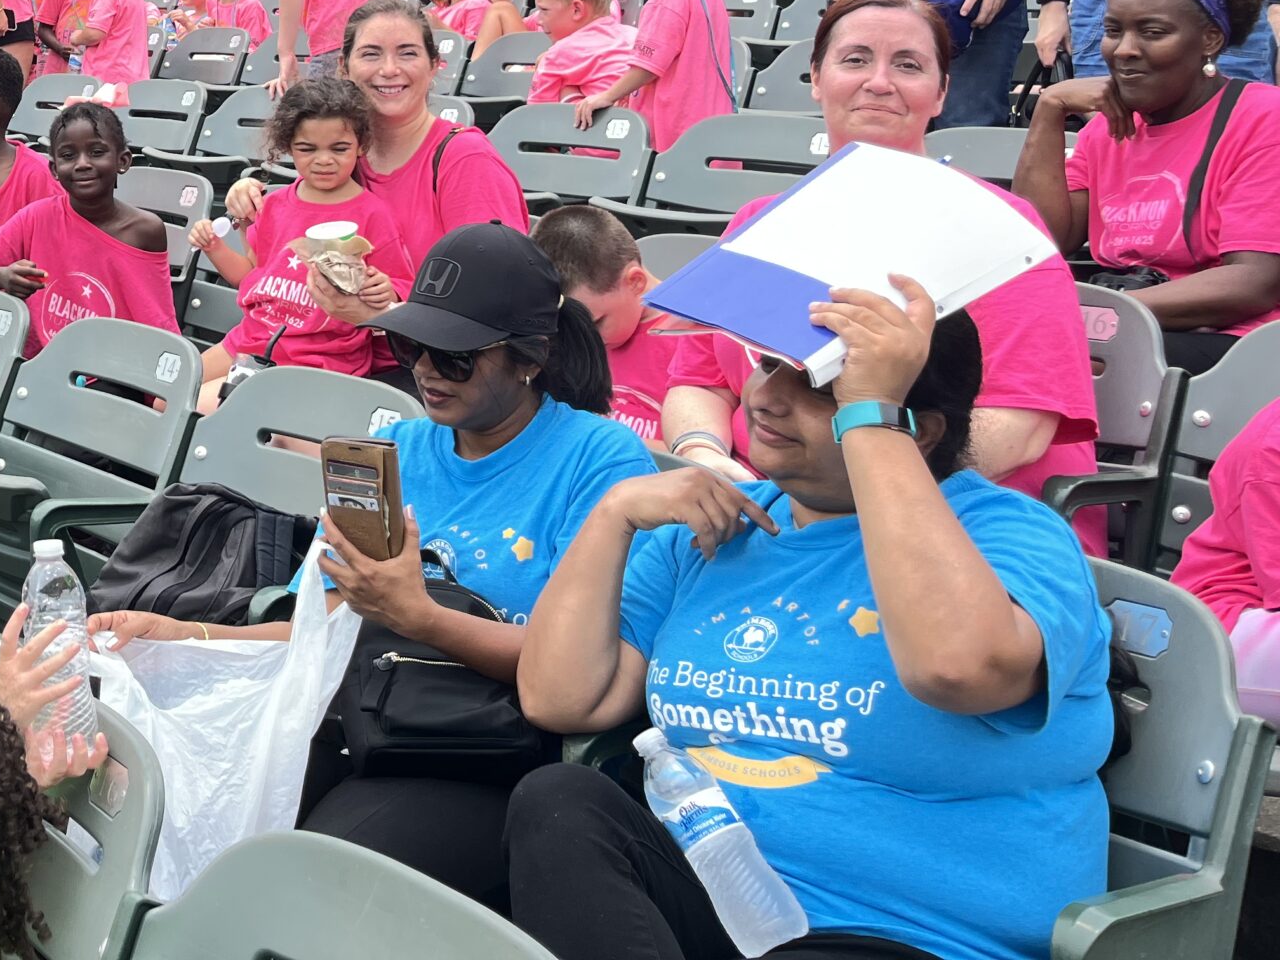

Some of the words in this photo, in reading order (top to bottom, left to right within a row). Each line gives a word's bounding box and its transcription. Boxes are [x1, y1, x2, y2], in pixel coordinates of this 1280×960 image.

[48, 292, 99, 322] BLACKM
[161, 356, 176, 378] 14
[772, 597, 810, 622] ART
[1118, 611, 1159, 647] 17
[673, 660, 841, 711] Beginning
[845, 681, 886, 716] of
[650, 693, 850, 758] Something
[742, 765, 802, 779] SCHOOLS
[678, 800, 700, 818] Oak
